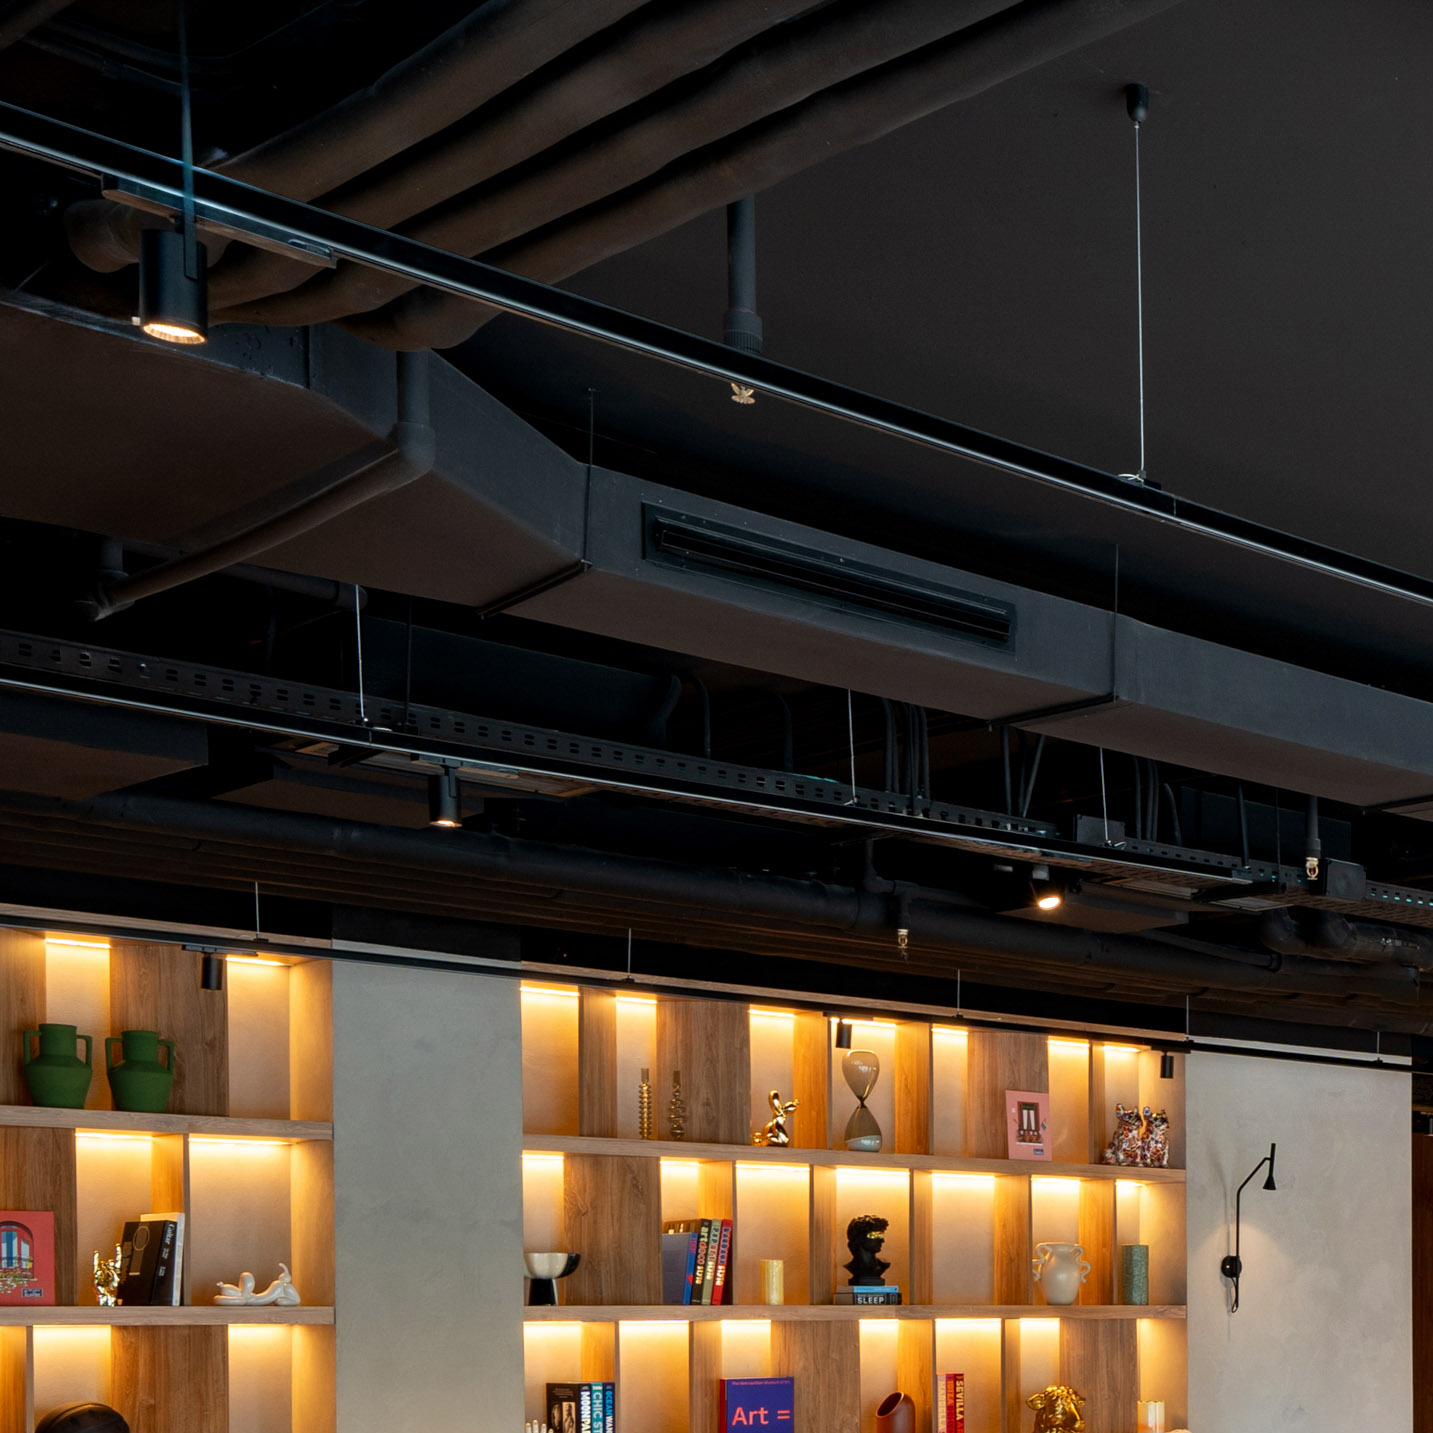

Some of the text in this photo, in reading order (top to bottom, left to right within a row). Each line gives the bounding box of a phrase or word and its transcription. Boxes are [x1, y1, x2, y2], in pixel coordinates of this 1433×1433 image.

[857, 1296, 885, 1305] SLEEP
[592, 1391, 603, 1419] CHIC
[956, 1380, 964, 1421] SEVILLA
[731, 1406, 769, 1426] Art
